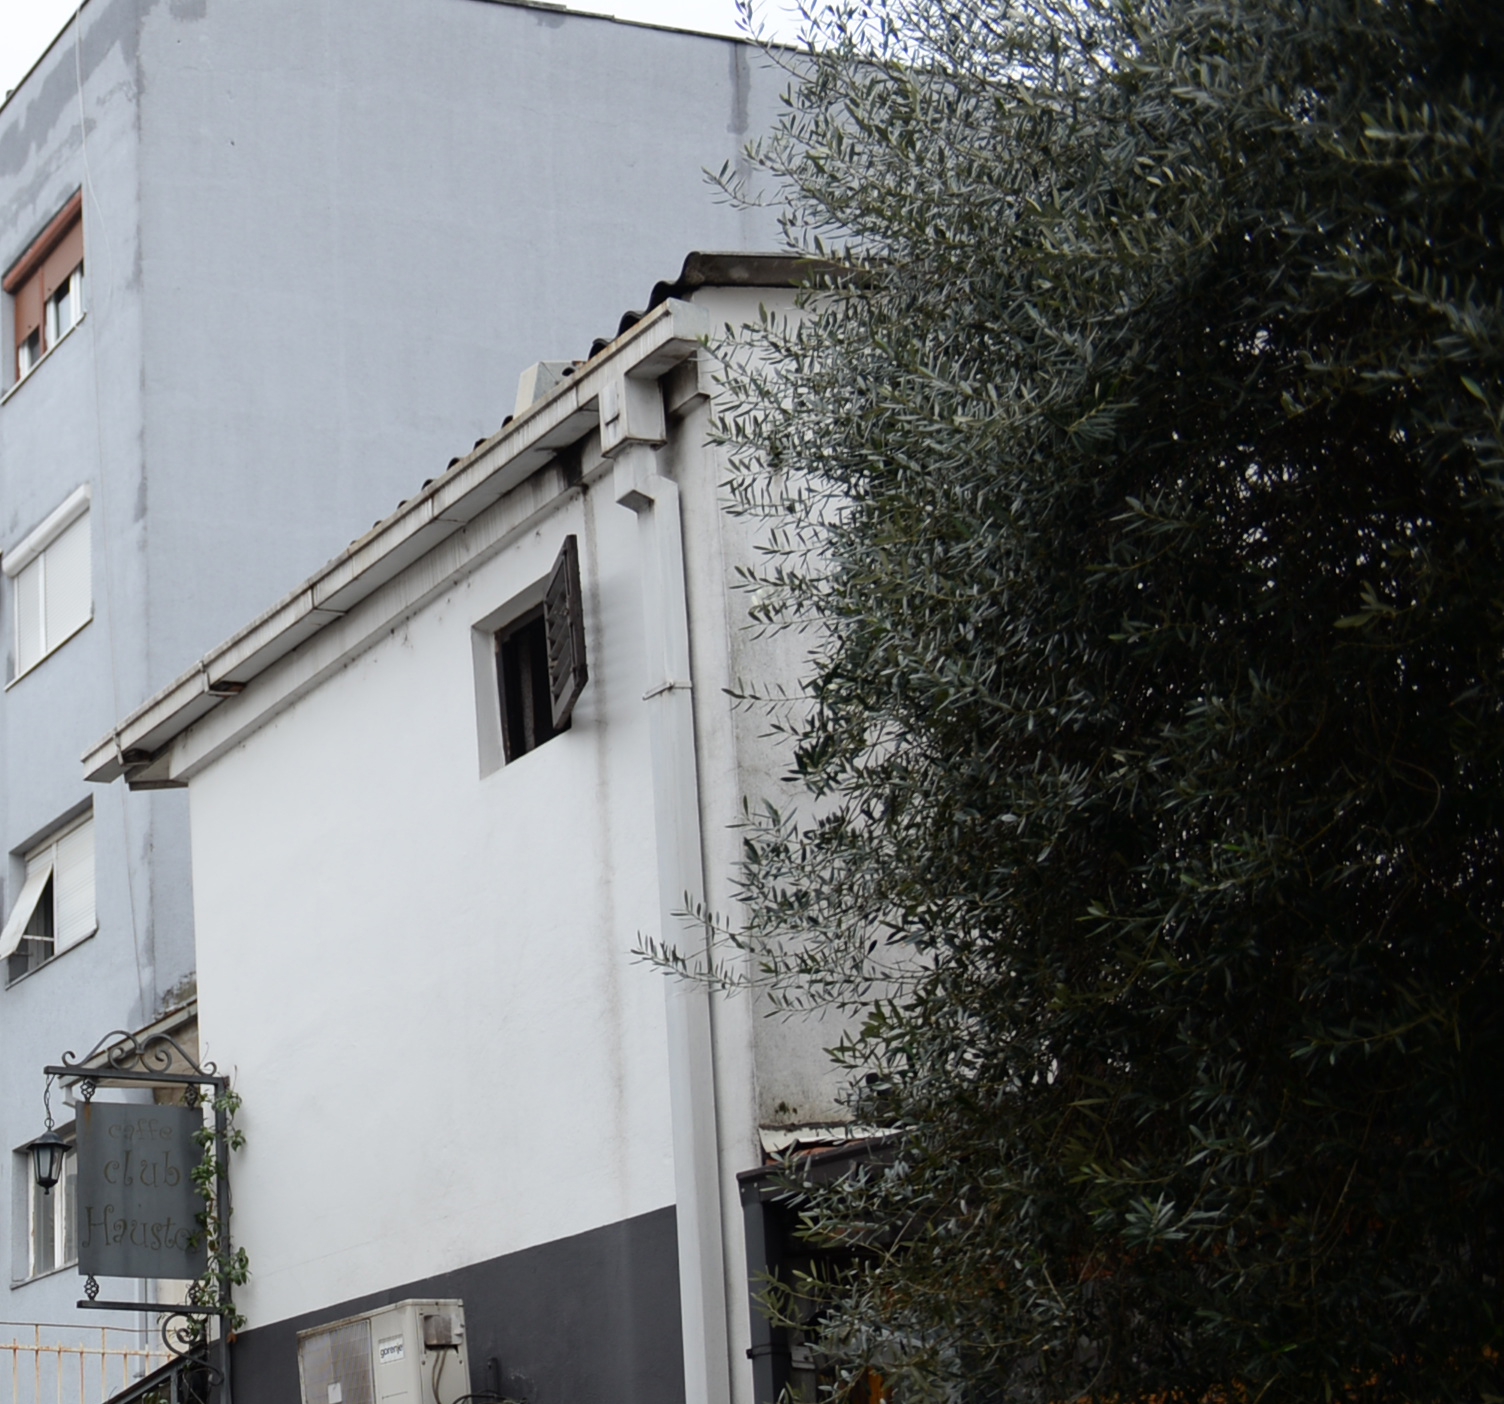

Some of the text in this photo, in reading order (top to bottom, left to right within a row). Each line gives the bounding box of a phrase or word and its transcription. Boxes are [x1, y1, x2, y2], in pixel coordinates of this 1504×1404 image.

[108, 1118, 173, 1140] caffe
[103, 1150, 181, 1187] club
[81, 1203, 207, 1252] Hausto
